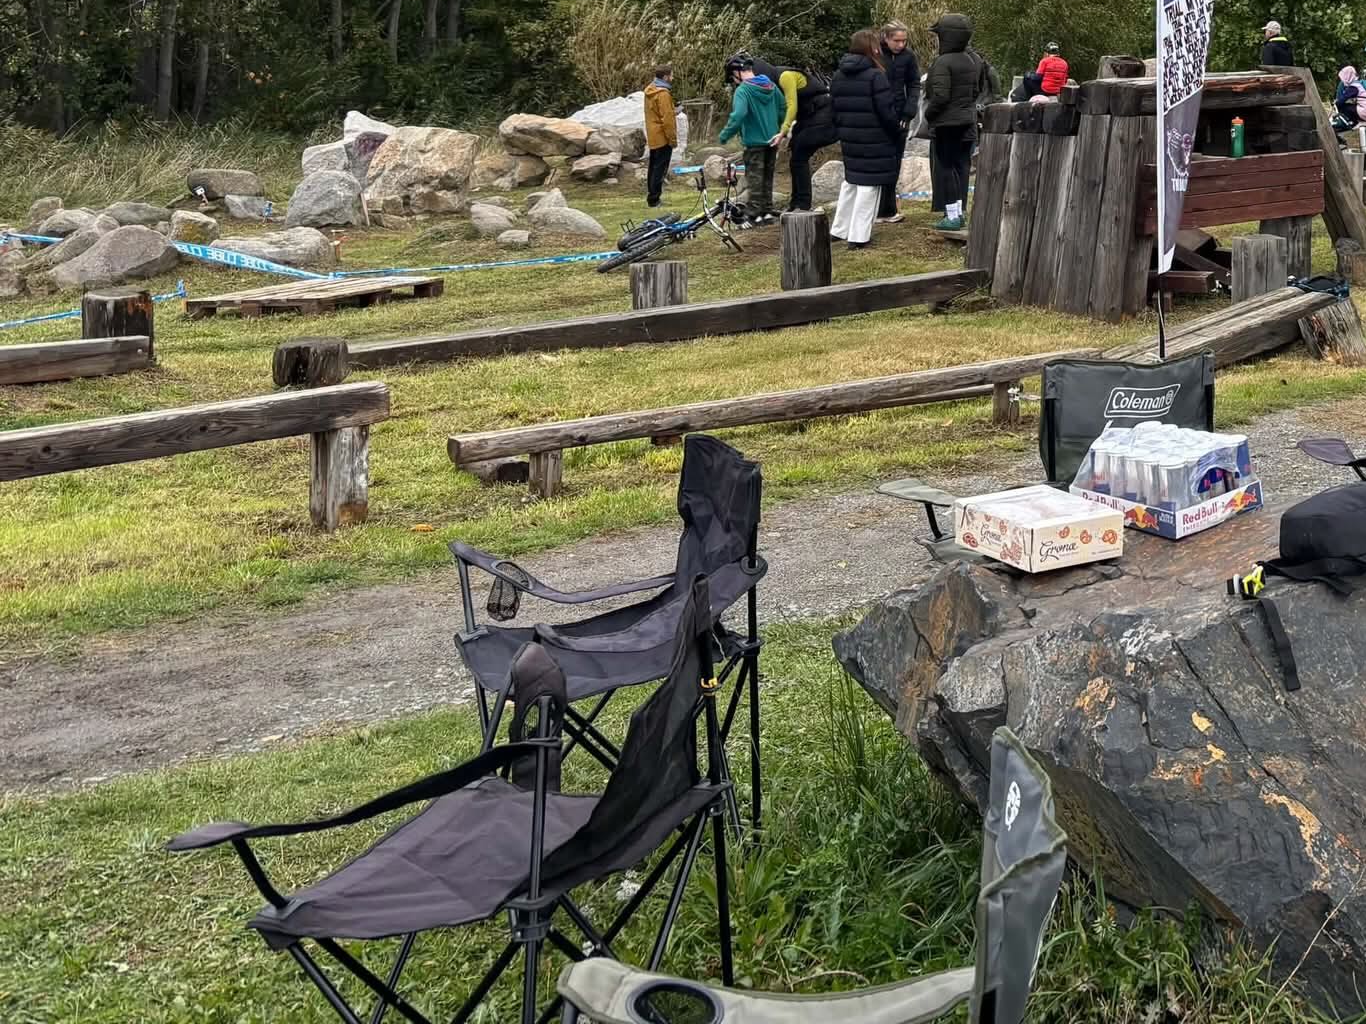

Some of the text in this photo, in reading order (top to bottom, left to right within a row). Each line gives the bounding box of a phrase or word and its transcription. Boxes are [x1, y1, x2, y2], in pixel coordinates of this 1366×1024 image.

[1112, 391, 1165, 410] Coleman
[1182, 506, 1200, 525] Red
[1201, 502, 1218, 518] Bull
